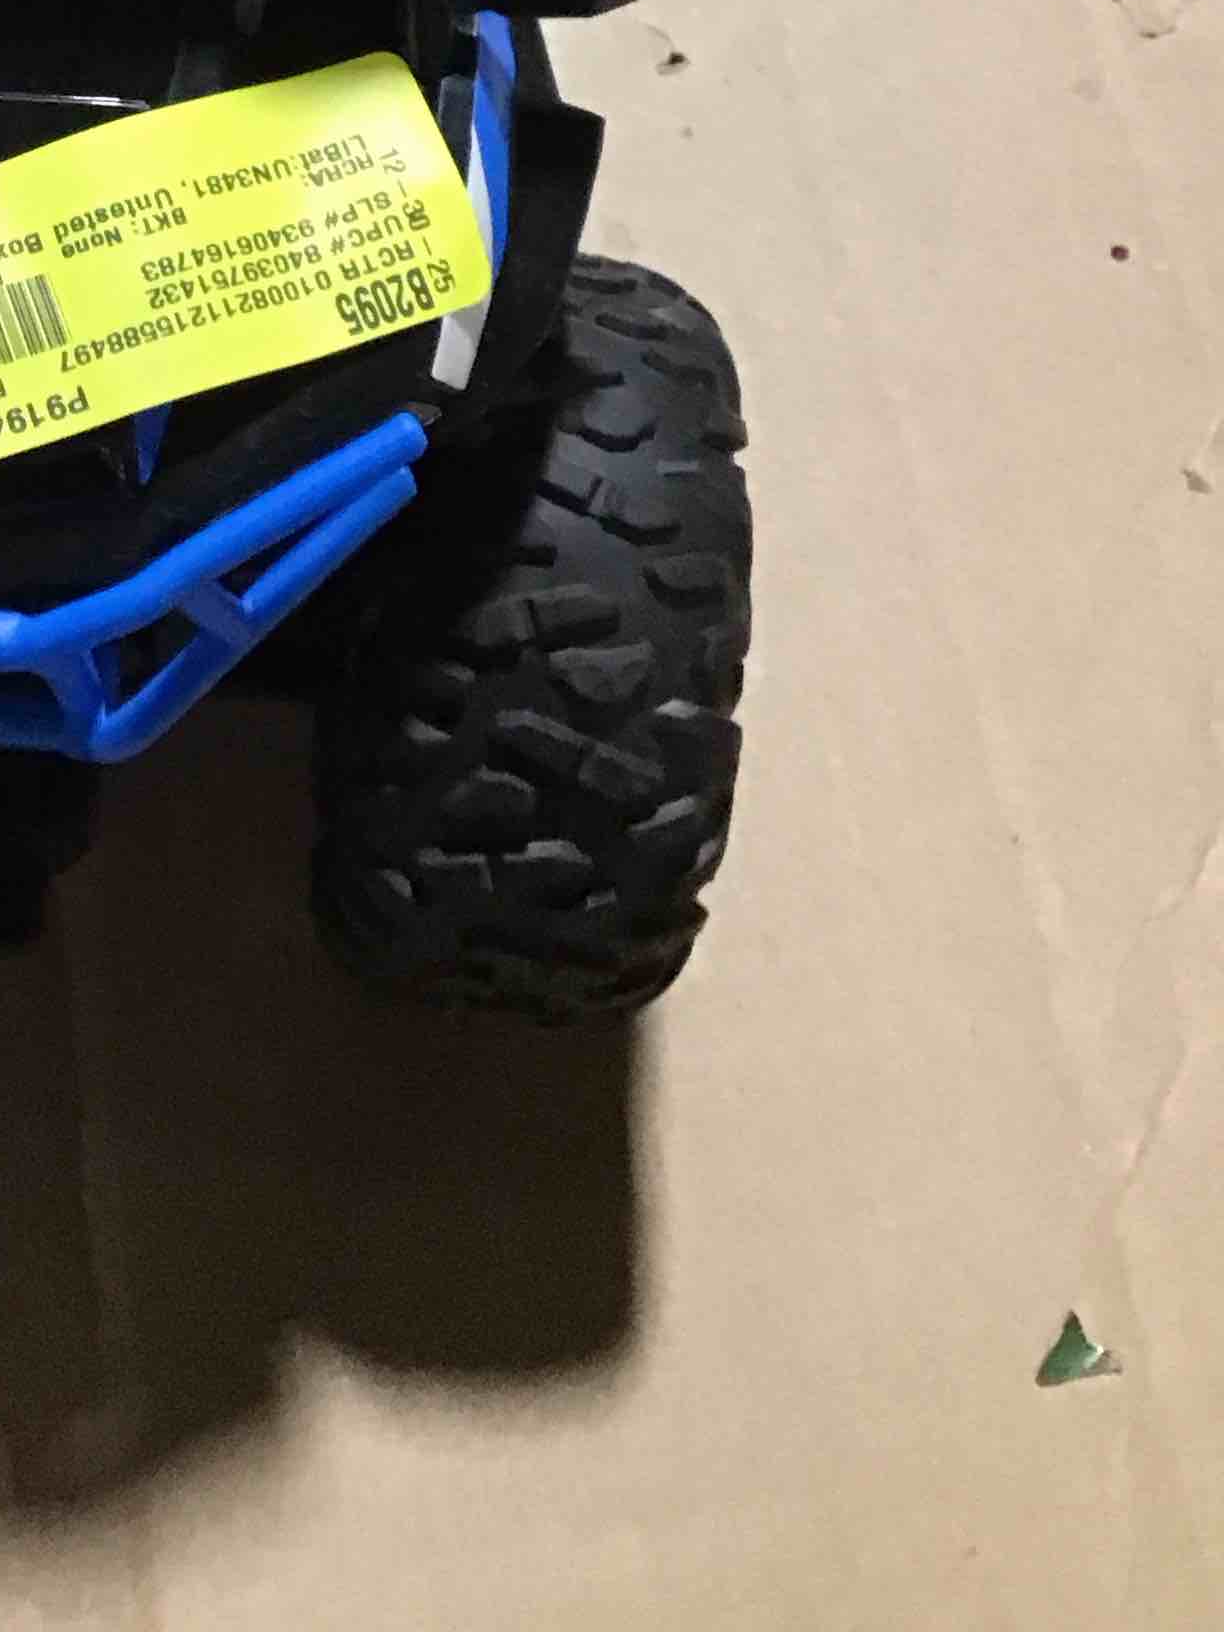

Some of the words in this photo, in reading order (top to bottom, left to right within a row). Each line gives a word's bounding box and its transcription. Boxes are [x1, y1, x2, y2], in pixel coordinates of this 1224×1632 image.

[51, 185, 174, 243] Untested
[321, 190, 393, 231] SLP#
[328, 214, 403, 256] UPC#
[59, 225, 123, 259] None
[139, 215, 316, 284] 93406164783
[336, 239, 416, 283] RCTR
[143, 241, 323, 311] 84039751432
[331, 266, 436, 338] B2095
